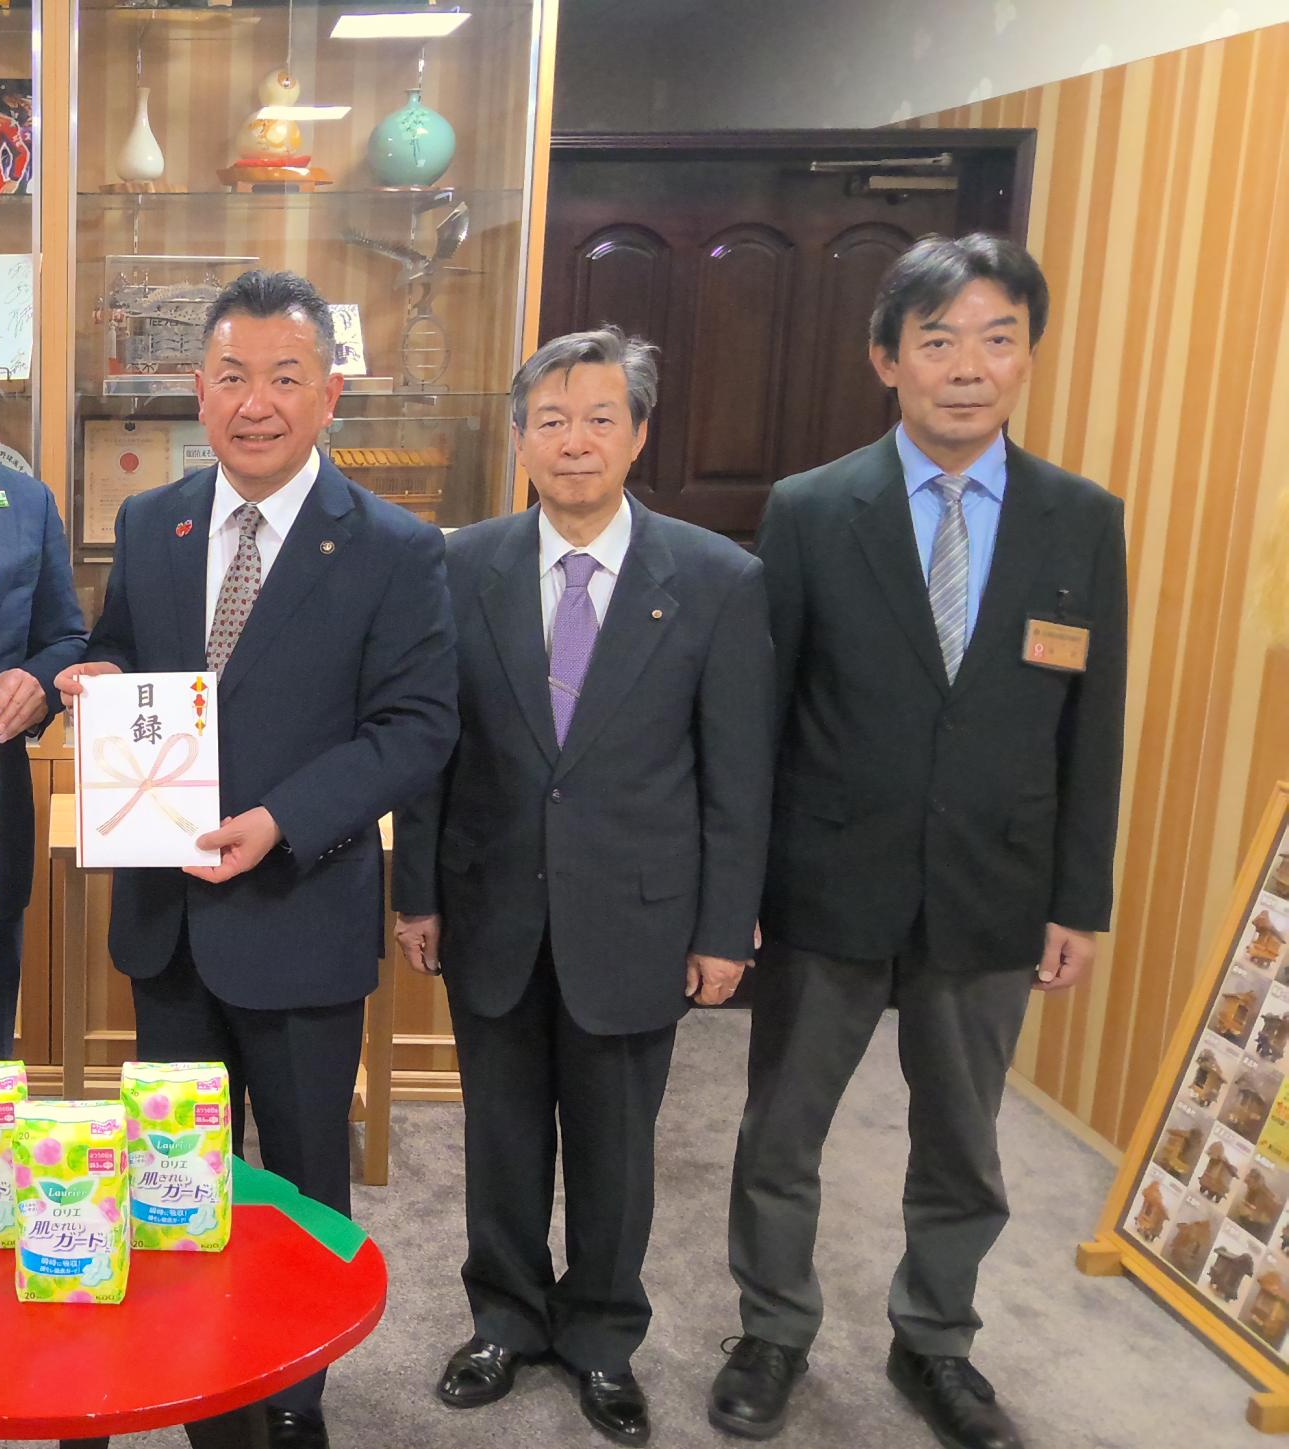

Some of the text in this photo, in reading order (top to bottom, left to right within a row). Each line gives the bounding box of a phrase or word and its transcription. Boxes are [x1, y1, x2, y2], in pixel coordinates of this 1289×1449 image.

[130, 683, 162, 744] 目録
[130, 1088, 139, 1097] 20
[18, 1132, 30, 1140] 20
[157, 1140, 193, 1150] Laurier
[161, 1160, 188, 1169] ロリエ
[139, 1172, 190, 1186] 肌きれい
[49, 1187, 88, 1197] Laurier
[161, 1184, 209, 1199] ガード
[53, 1208, 81, 1217] ロリエ
[29, 1220, 83, 1235] 肌きれい
[54, 1232, 104, 1248] ガード
[132, 1240, 144, 1248] 20
[24, 1292, 36, 1300] 20
